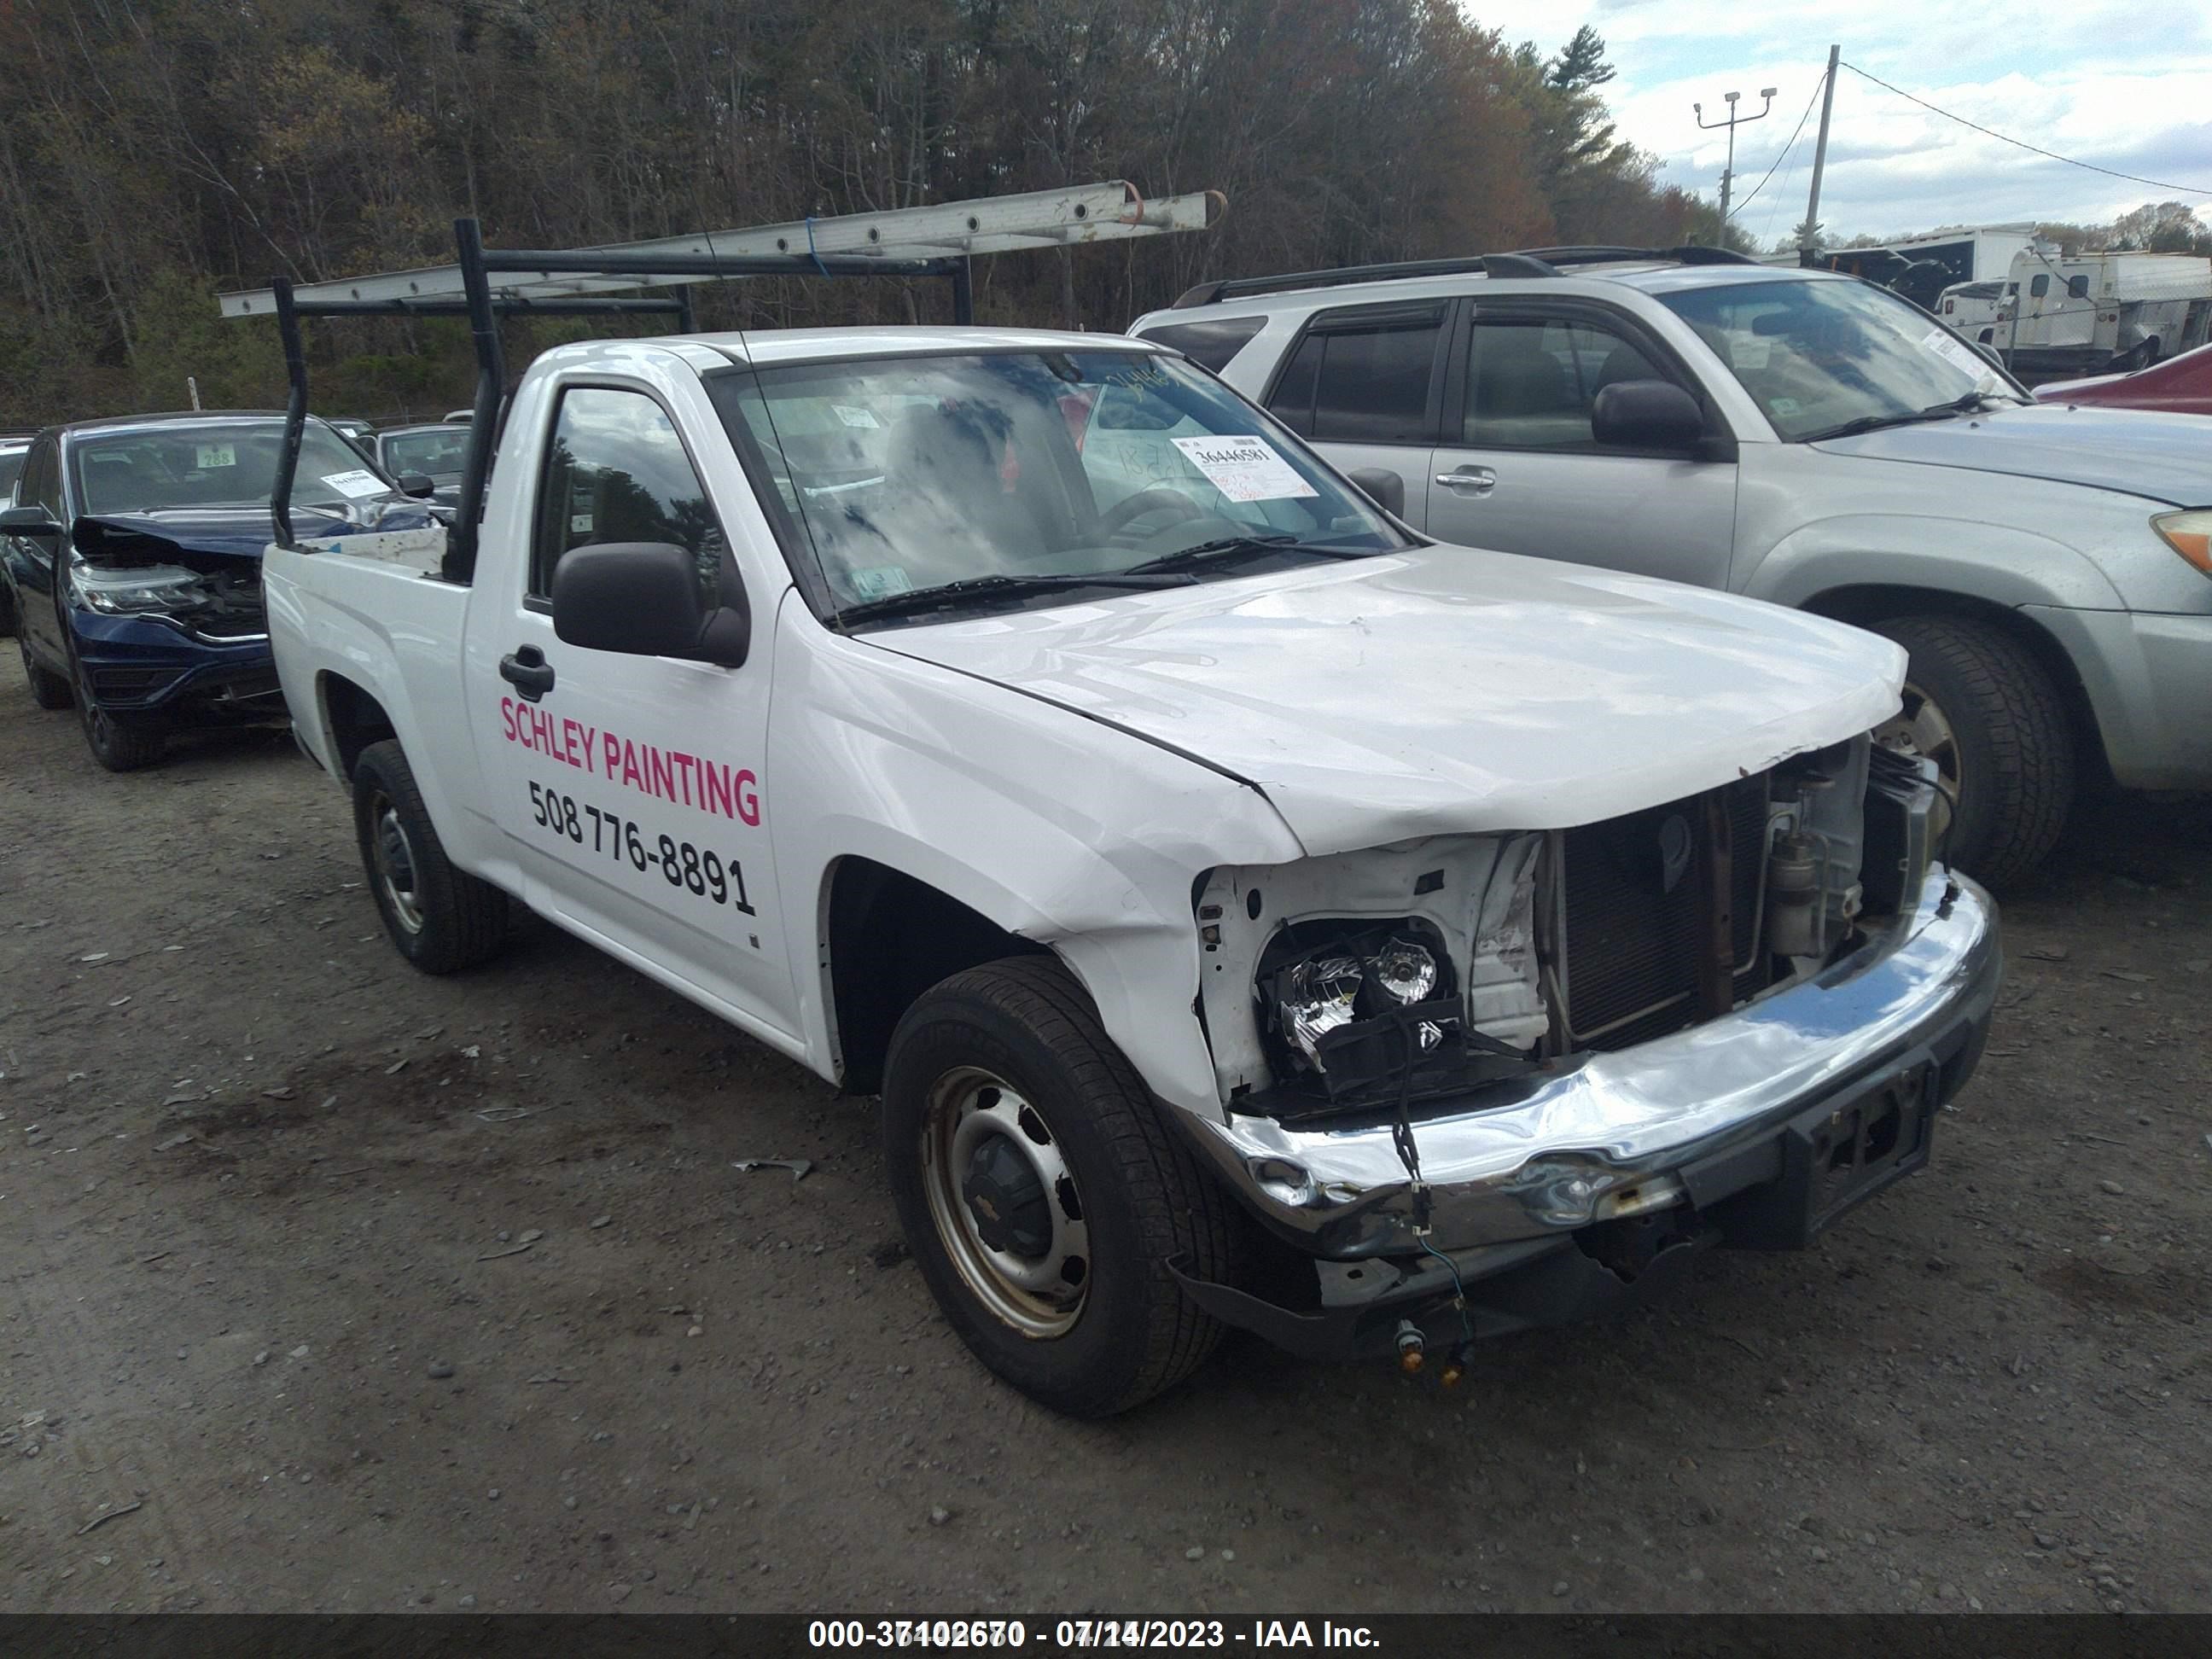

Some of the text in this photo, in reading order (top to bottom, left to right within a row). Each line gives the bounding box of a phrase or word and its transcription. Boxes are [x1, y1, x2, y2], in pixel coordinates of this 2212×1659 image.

[205, 453, 230, 466] 288
[1196, 448, 1272, 464] 36446581
[501, 696, 760, 827] SCHLEY PAINTING
[529, 780, 756, 917] 508 776-8891
